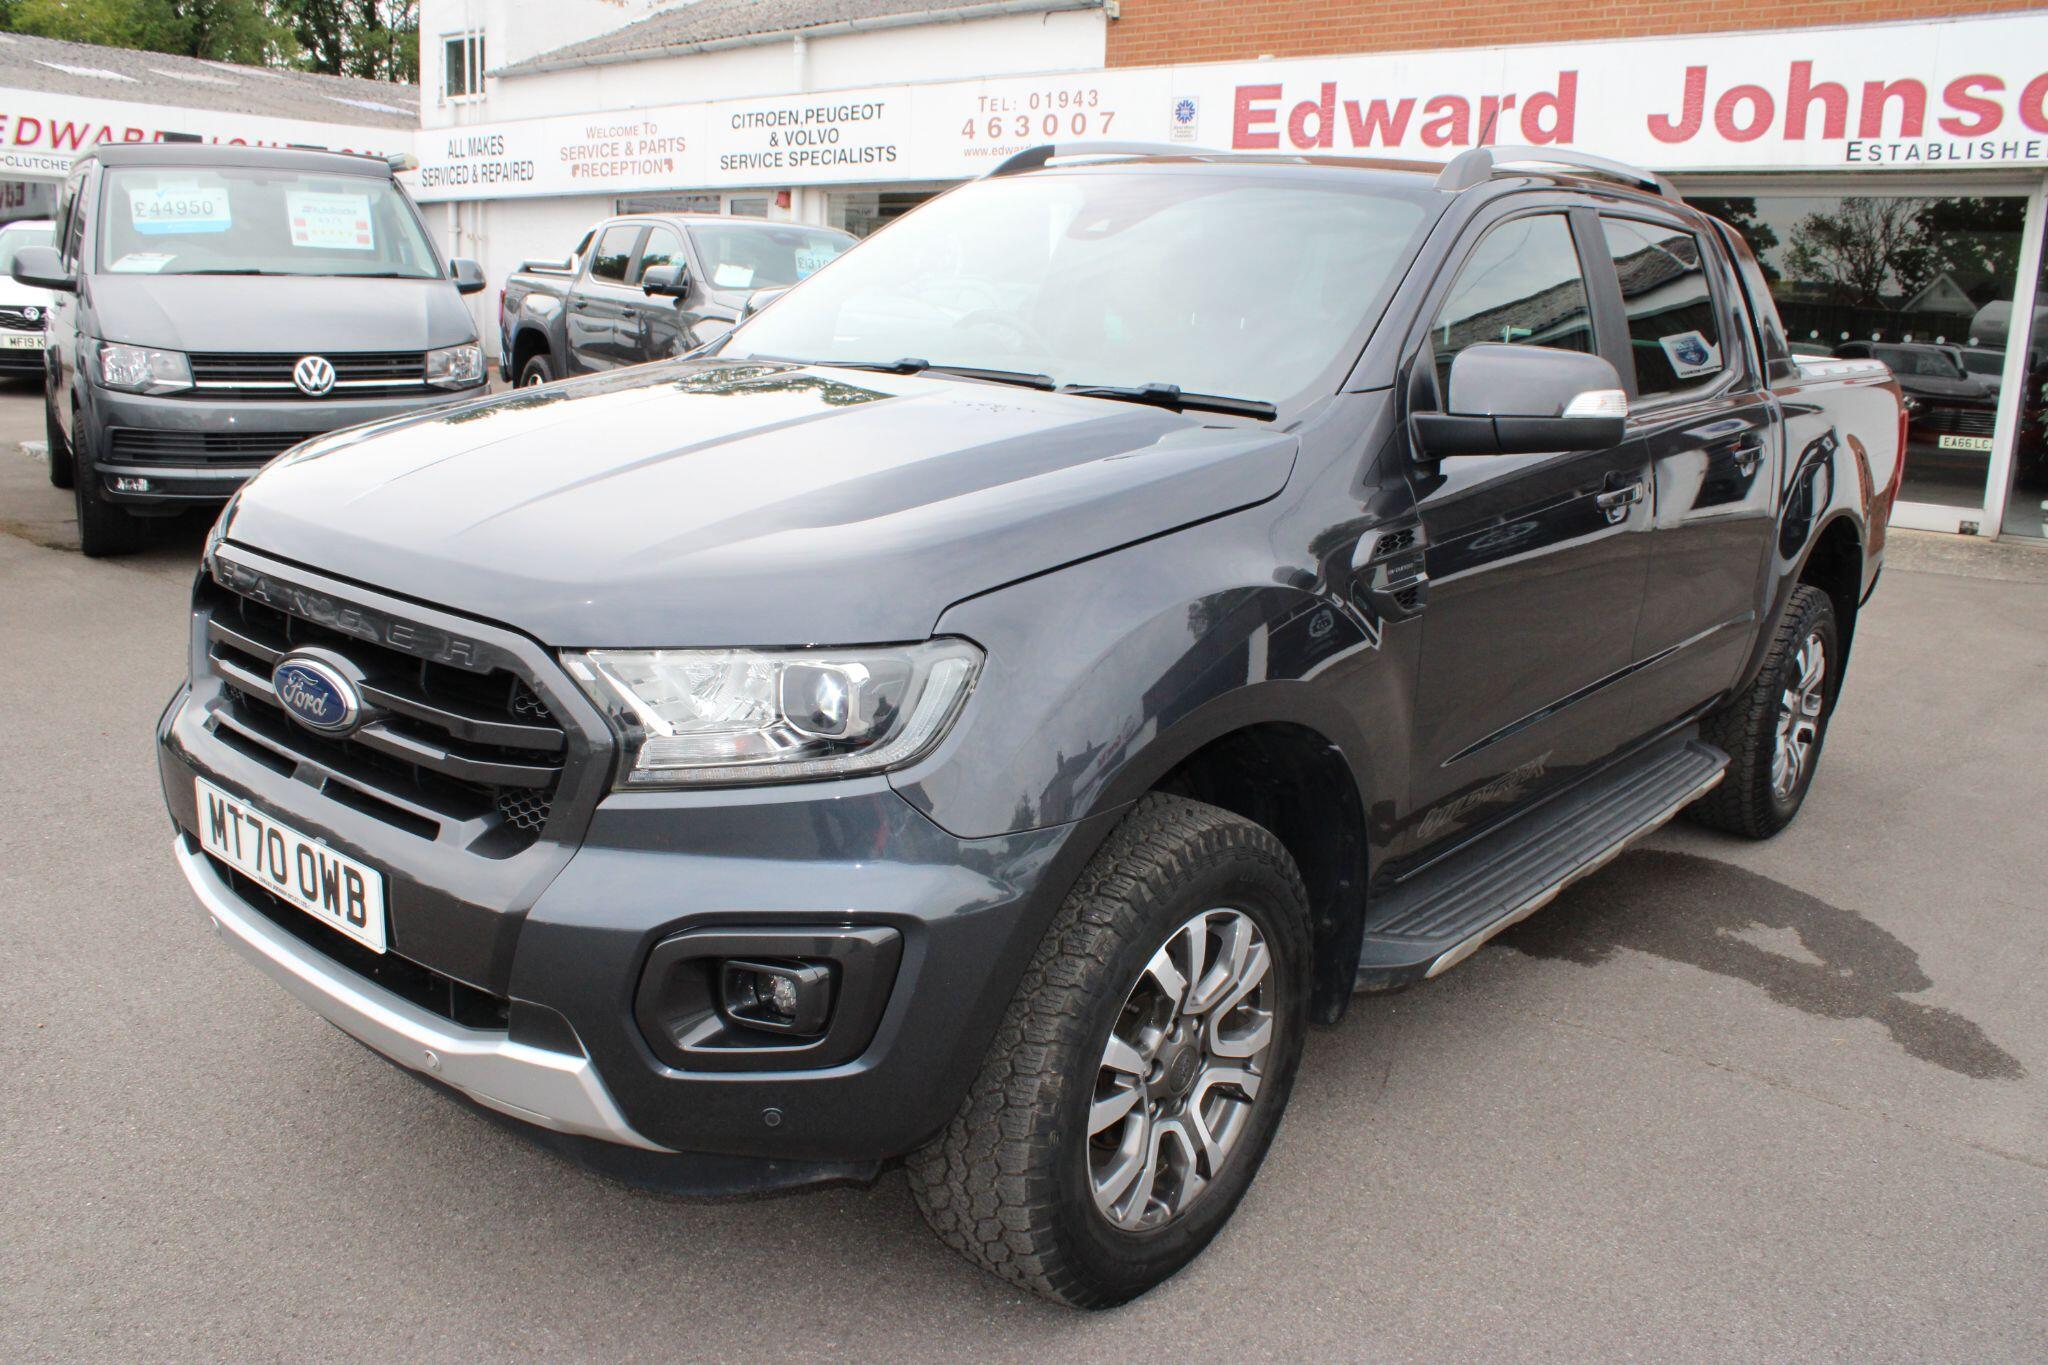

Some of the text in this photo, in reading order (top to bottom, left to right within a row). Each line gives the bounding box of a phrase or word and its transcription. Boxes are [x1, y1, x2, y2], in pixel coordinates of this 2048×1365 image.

[1029, 89, 1099, 110] 01943
[1232, 70, 1578, 150] Edward
[448, 135, 504, 159] ALL MAKES
[560, 136, 686, 162] SERVICE & PARTS
[769, 128, 840, 147] & VOLVO
[720, 145, 897, 170] SERVICE SPECIALISTS
[1846, 141, 2048, 161] ESTABLISHE
[421, 160, 535, 188] SERVICED & REPAIRED
[581, 159, 663, 178] RECEPTION
[134, 200, 215, 217] £44950
[218, 562, 474, 667] RANGER
[283, 669, 329, 717] Ford
[209, 792, 367, 929] MT70 OWB
